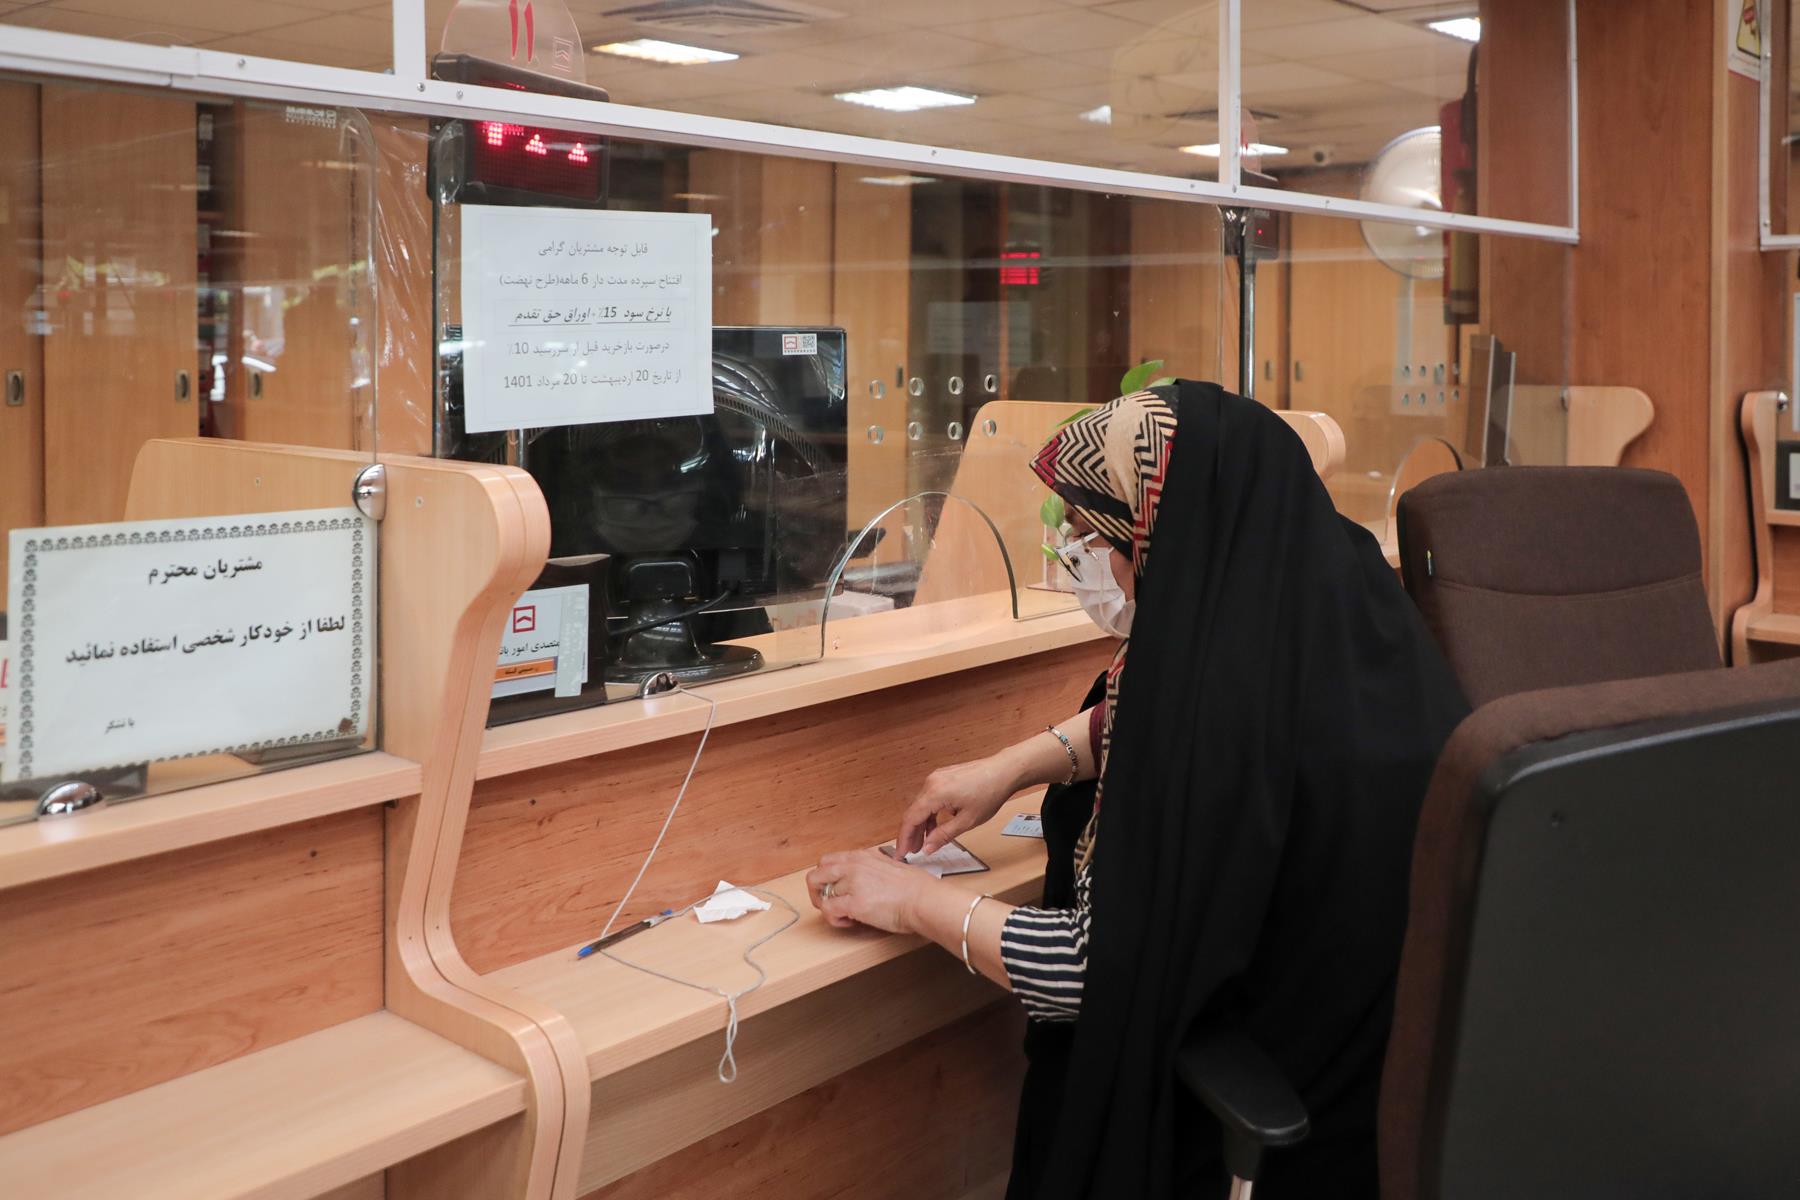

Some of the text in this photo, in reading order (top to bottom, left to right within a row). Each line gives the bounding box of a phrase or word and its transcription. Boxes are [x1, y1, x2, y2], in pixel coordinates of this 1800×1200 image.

[538, 240, 648, 257] قابل توجه مشتریان گرامی
[581, 272, 589, 285] 6
[592, 272, 604, 289] دار
[607, 276, 628, 285] مدت
[630, 277, 656, 289] سپرده
[658, 273, 682, 289] افتتاح
[514, 308, 542, 322] تقدم
[542, 309, 561, 323] حق
[563, 307, 591, 322] اوراق
[623, 309, 644, 321] سود
[645, 307, 664, 321] نرخ
[665, 306, 672, 320] با
[582, 340, 599, 356] قبل
[503, 368, 681, 390] از تاریخ 20 اردیبهشت تا 20 مرداد 1401
[148, 556, 263, 585] مشتریان محترم
[299, 620, 312, 640] از
[316, 615, 345, 632] لطفا
[182, 628, 235, 654] شخصی
[239, 621, 294, 647] خودکار
[119, 635, 177, 656] استفاده
[511, 642, 529, 657] امور
[103, 716, 136, 736] با تشکر
